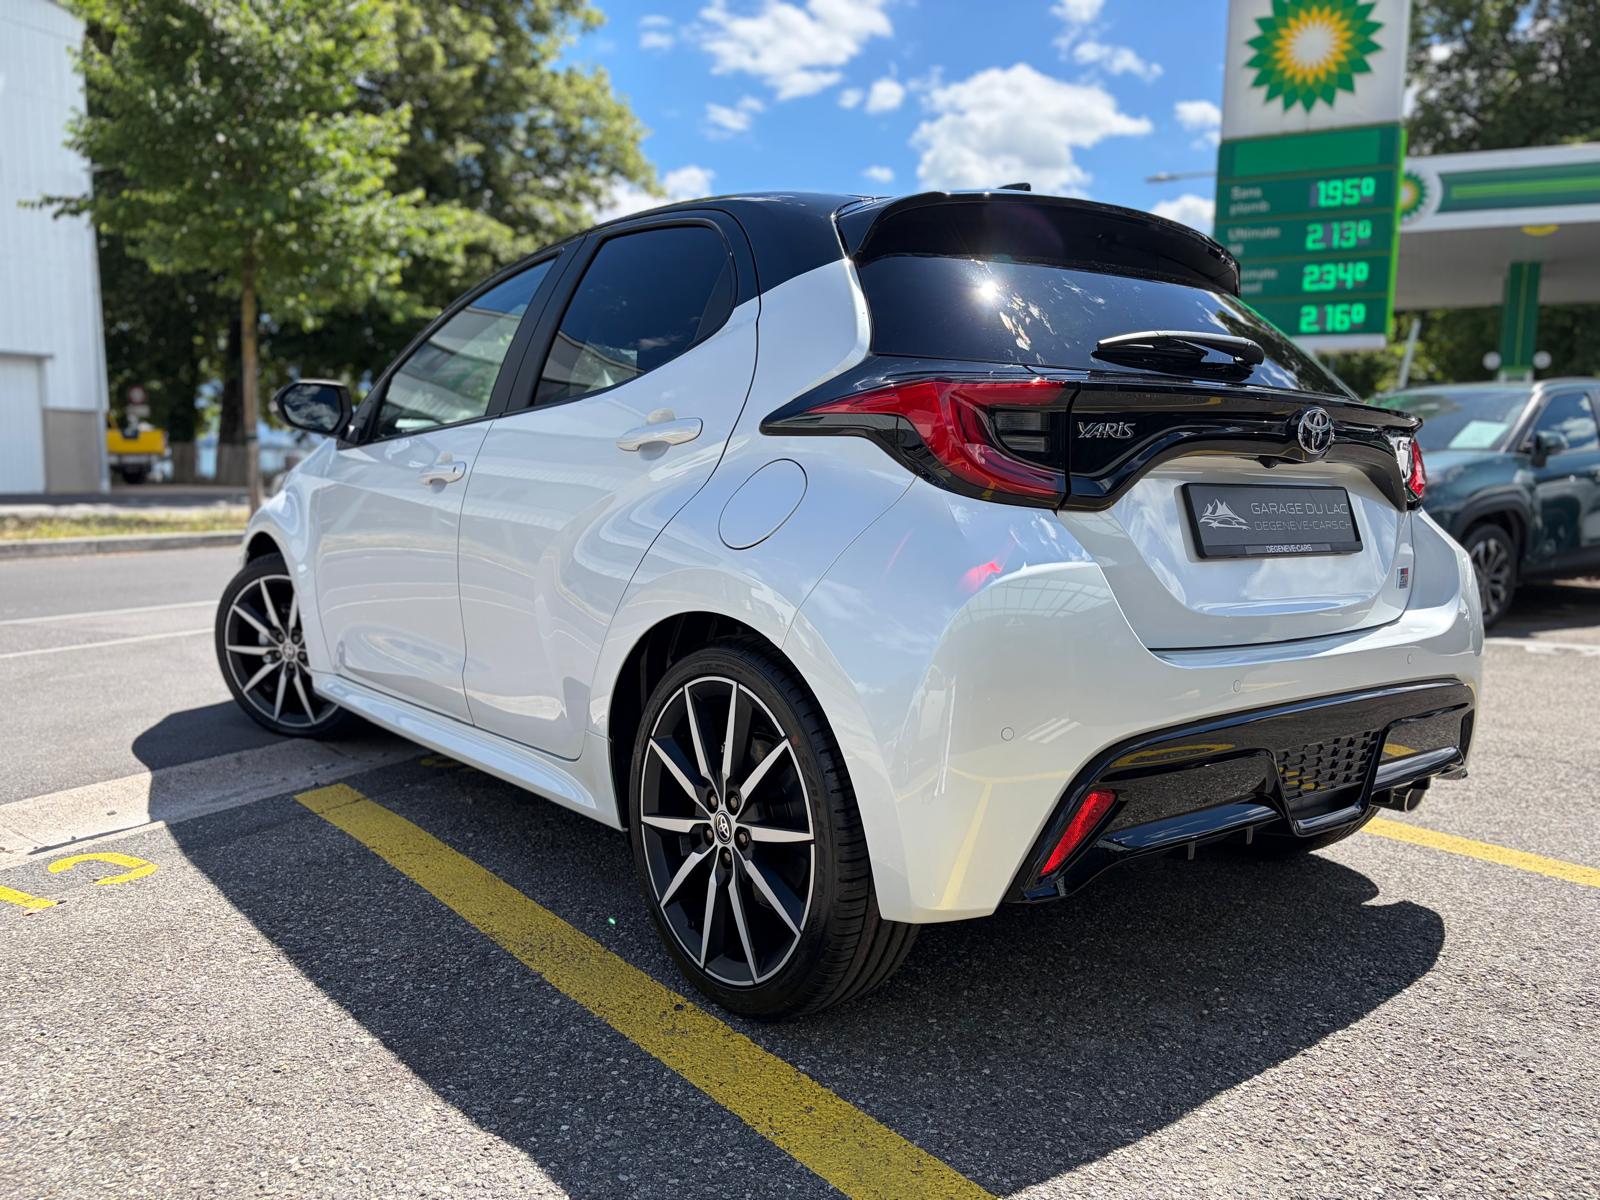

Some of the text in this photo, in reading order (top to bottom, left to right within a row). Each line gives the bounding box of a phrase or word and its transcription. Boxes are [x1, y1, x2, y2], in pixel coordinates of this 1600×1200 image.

[1077, 421, 1136, 439] YARIS
[1251, 502, 1348, 515] GARAGE DU LAC
